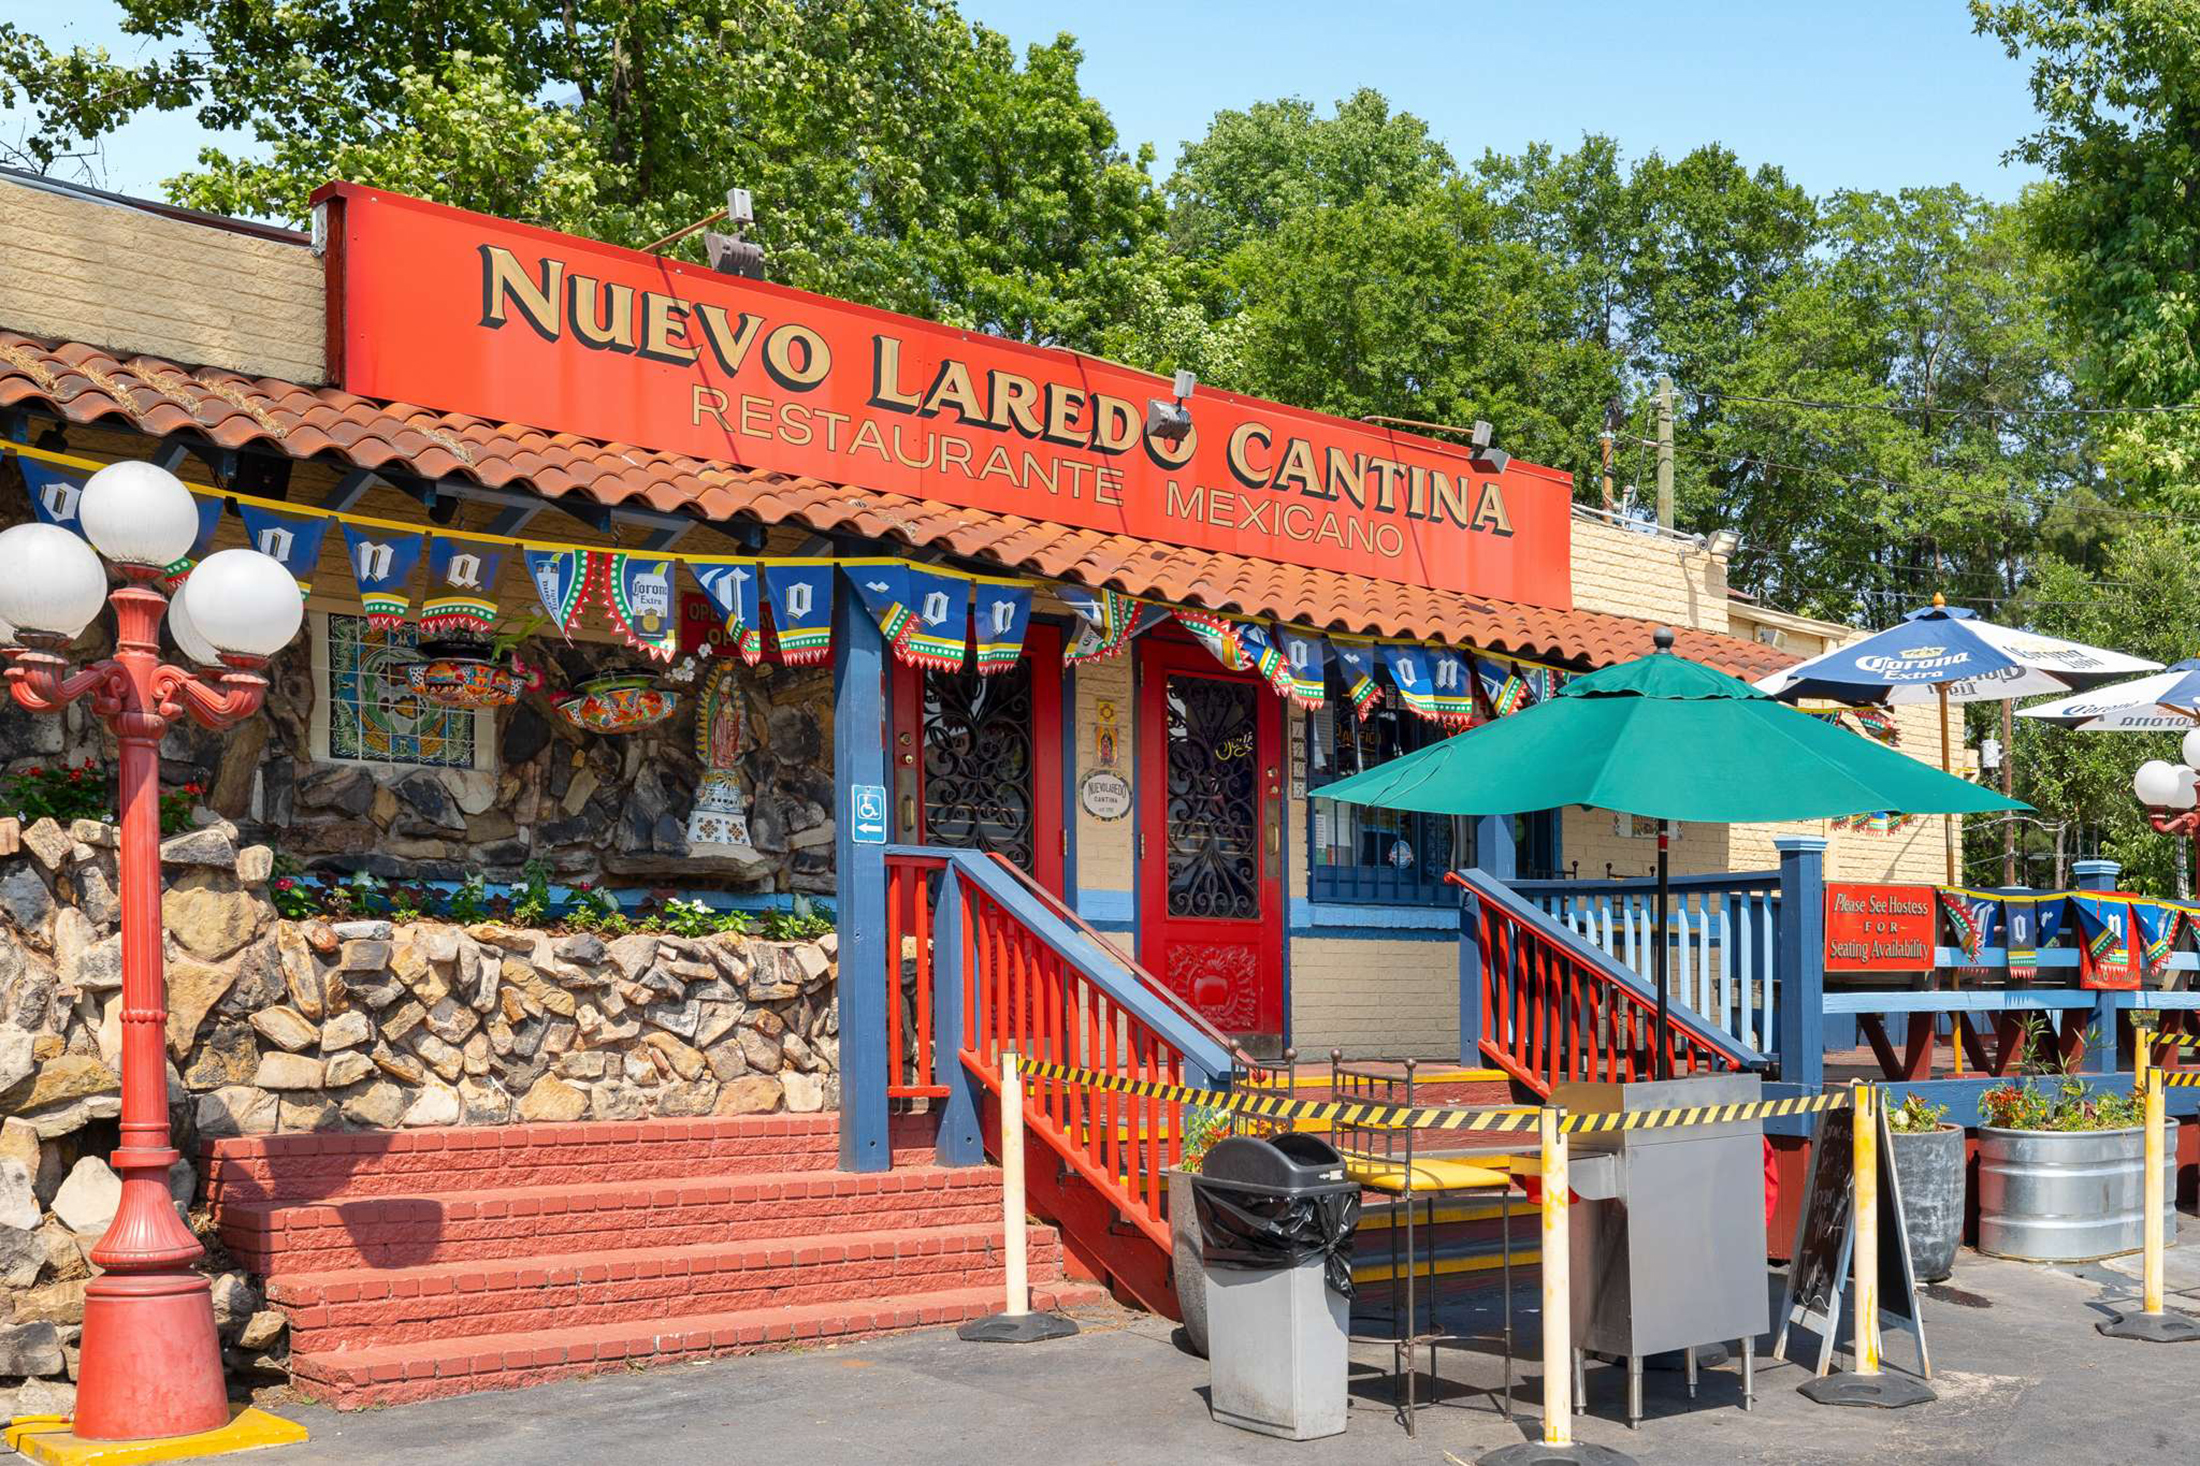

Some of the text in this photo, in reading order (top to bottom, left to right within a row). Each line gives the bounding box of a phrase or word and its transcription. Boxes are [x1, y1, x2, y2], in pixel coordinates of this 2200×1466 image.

[478, 244, 832, 392] NUEVO
[1227, 421, 1514, 538] CANTINA
[691, 383, 1404, 558] RESTAURANTE MEXICANO
[1855, 651, 1972, 672] Corona
[1882, 670, 1943, 680] Extra
[1833, 893, 1928, 916] Please See Hostess
[1864, 921, 1898, 934] FOR
[1830, 938, 1931, 964] Seating Availability
